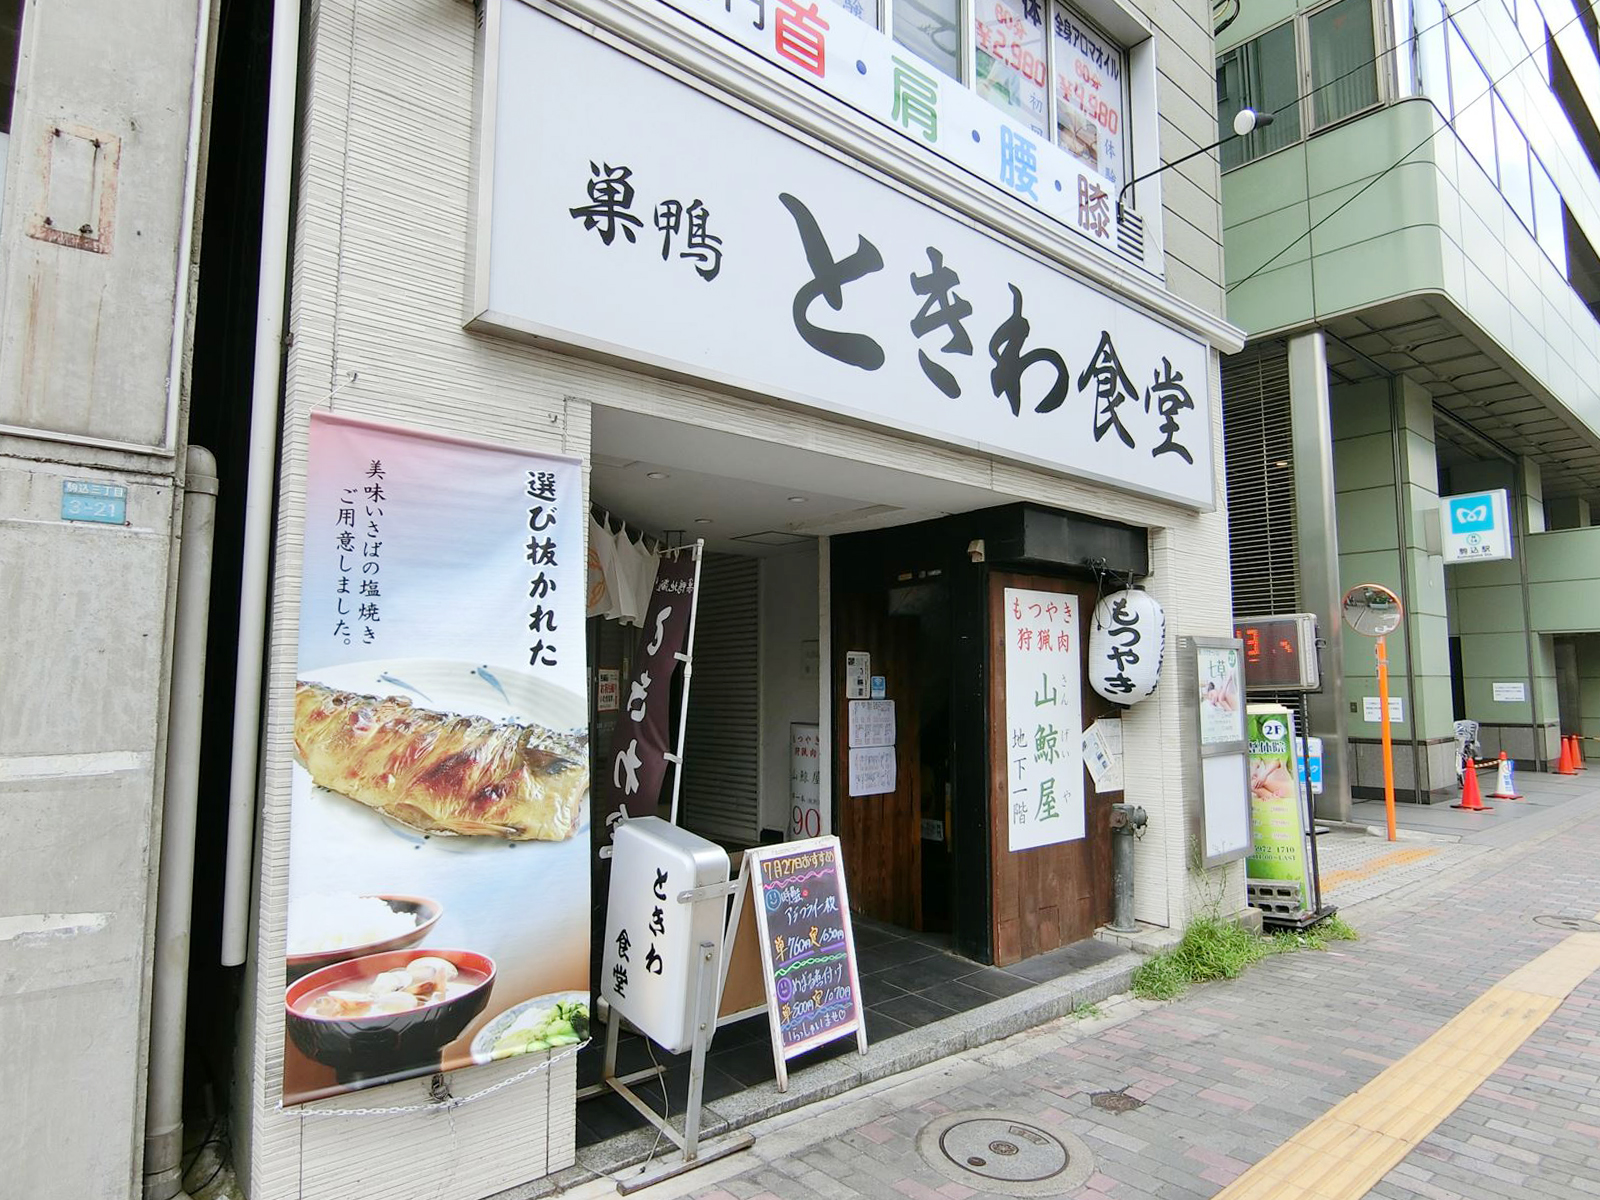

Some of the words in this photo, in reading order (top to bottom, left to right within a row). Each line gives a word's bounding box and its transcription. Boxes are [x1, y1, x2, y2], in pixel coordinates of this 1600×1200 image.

[1054, 12, 1119, 81] 全身アロマオイル
[569, 160, 723, 283] 巣鴨
[778, 192, 1194, 466] ときわ食堂
[67, 481, 124, 498] 駒込三丁目
[68, 499, 116, 518] 3-21
[333, 488, 358, 646] ご用意しました。
[358, 459, 387, 645] 美味いさばの塩焼き
[526, 470, 559, 667] 選び抜かれた
[1012, 596, 1073, 624] もつやき
[1017, 628, 1070, 653] 狩猟肉
[1104, 597, 1142, 695] もつやき
[1033, 672, 1061, 823] 山鯨屋
[1264, 725, 1282, 735] 2F
[1011, 728, 1029, 826] 地下一階
[763, 850, 834, 881] 7月27日おすすめ
[645, 867, 669, 976] ときわ
[613, 929, 632, 999] 食堂
